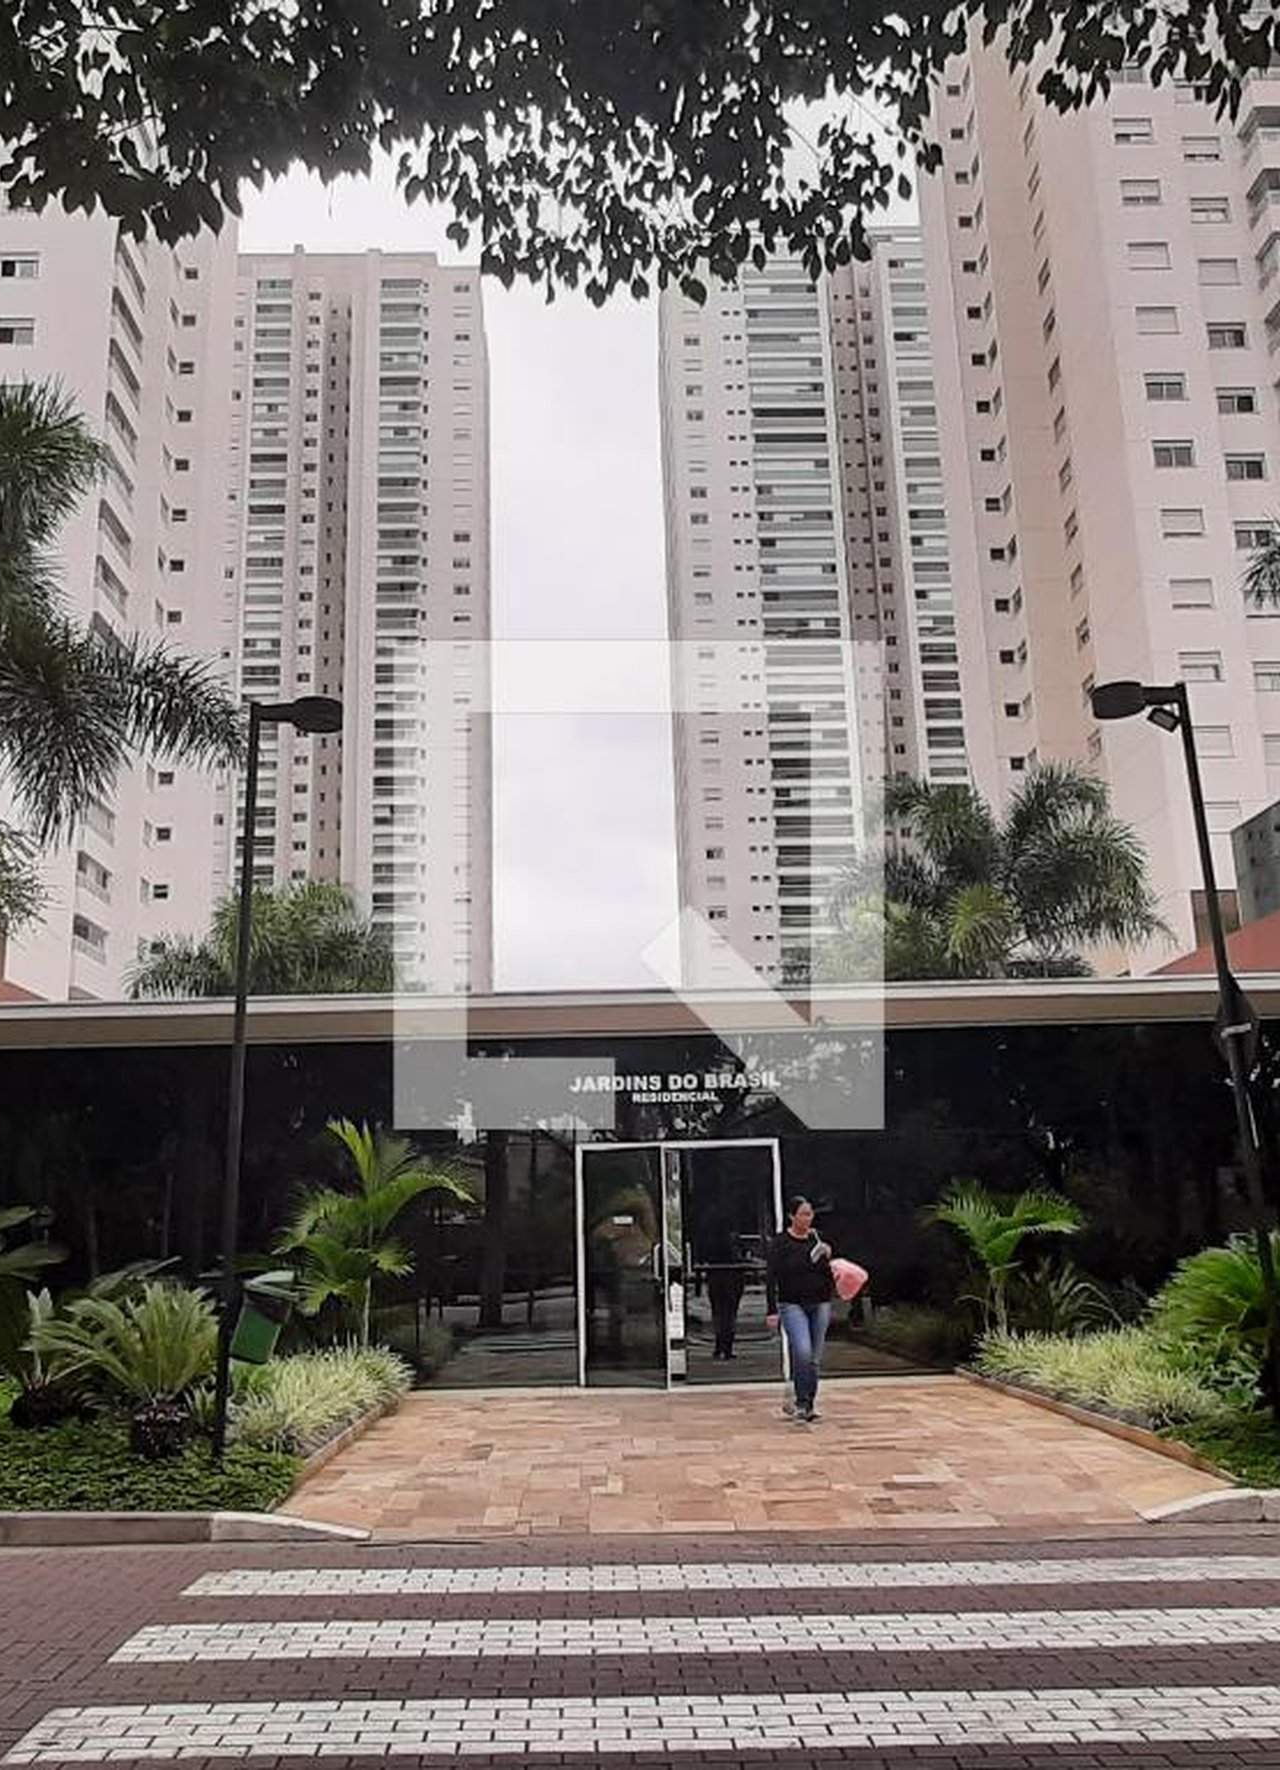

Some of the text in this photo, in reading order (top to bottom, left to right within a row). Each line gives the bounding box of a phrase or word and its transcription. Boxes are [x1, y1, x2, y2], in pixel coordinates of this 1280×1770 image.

[570, 1071, 781, 1092] JARDINS DO BRASIL
[632, 1091, 719, 1103] RESIDENCIAL
